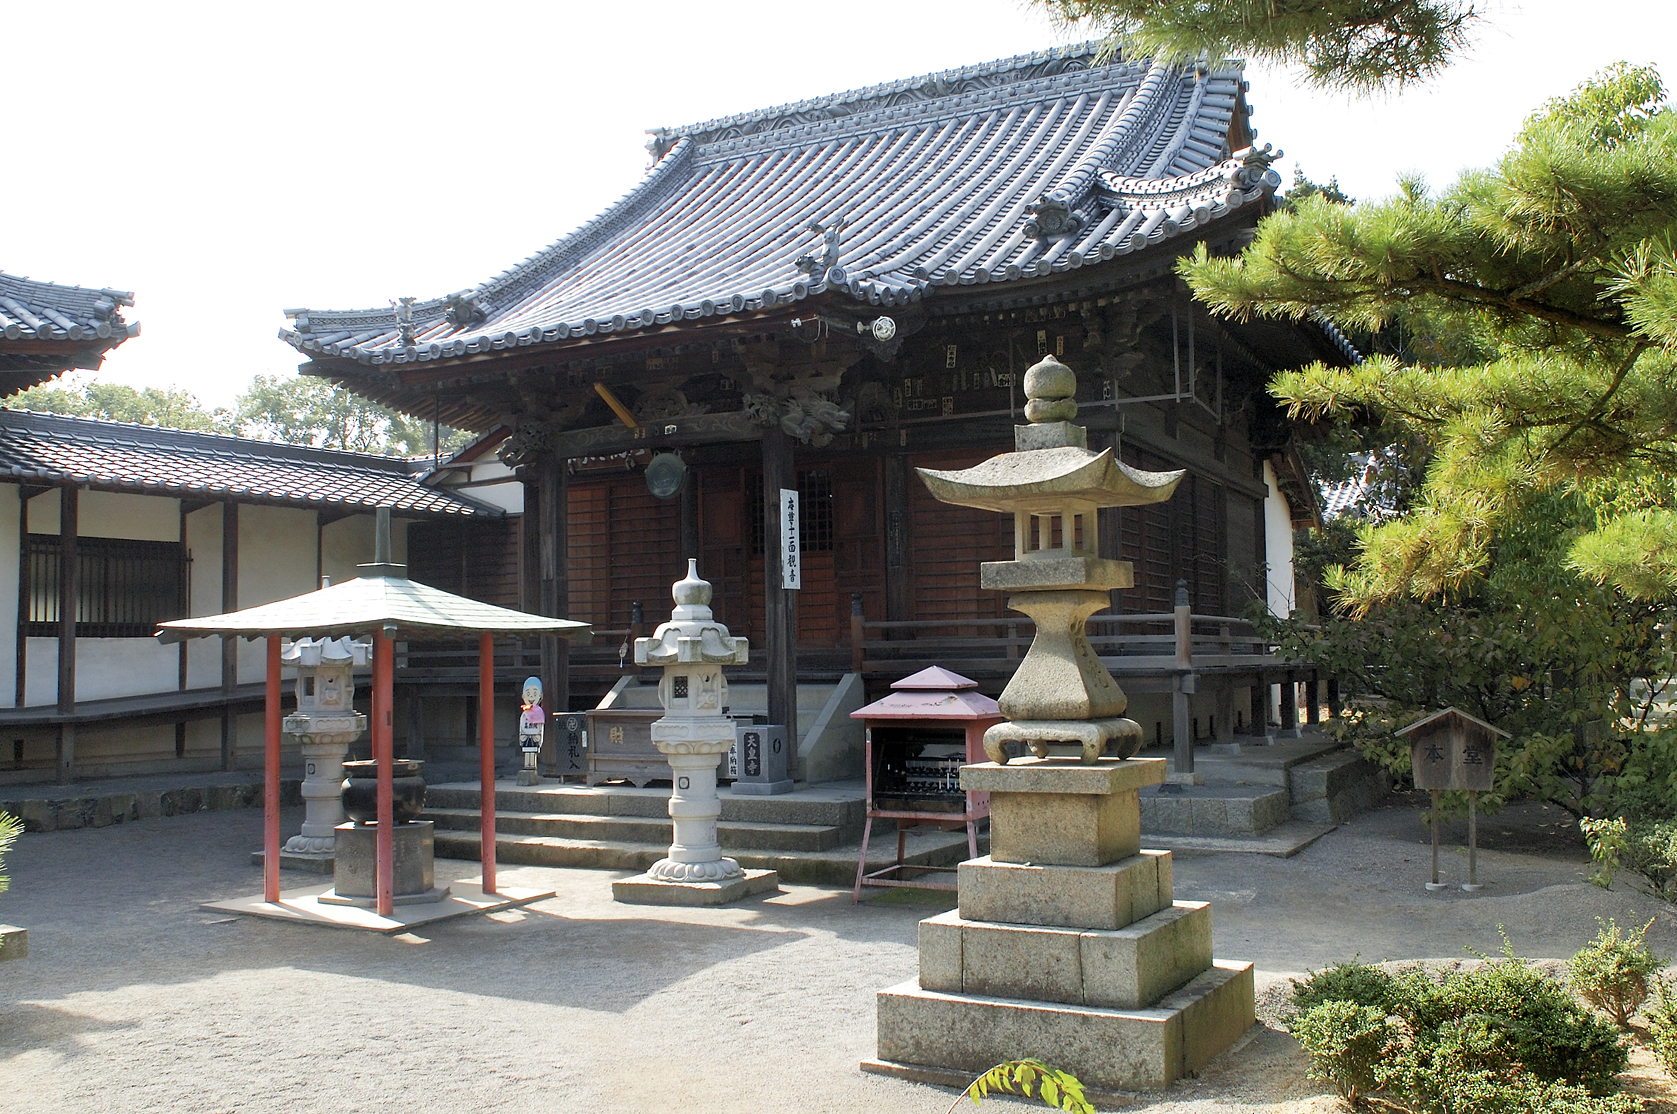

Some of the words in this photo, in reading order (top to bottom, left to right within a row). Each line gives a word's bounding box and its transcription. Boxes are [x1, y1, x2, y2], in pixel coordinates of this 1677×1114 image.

[609, 727, 623, 744] 財
[568, 732, 580, 770] 納札入
[747, 735, 758, 774] 天皇寺
[1424, 744, 1483, 765] 本堂
